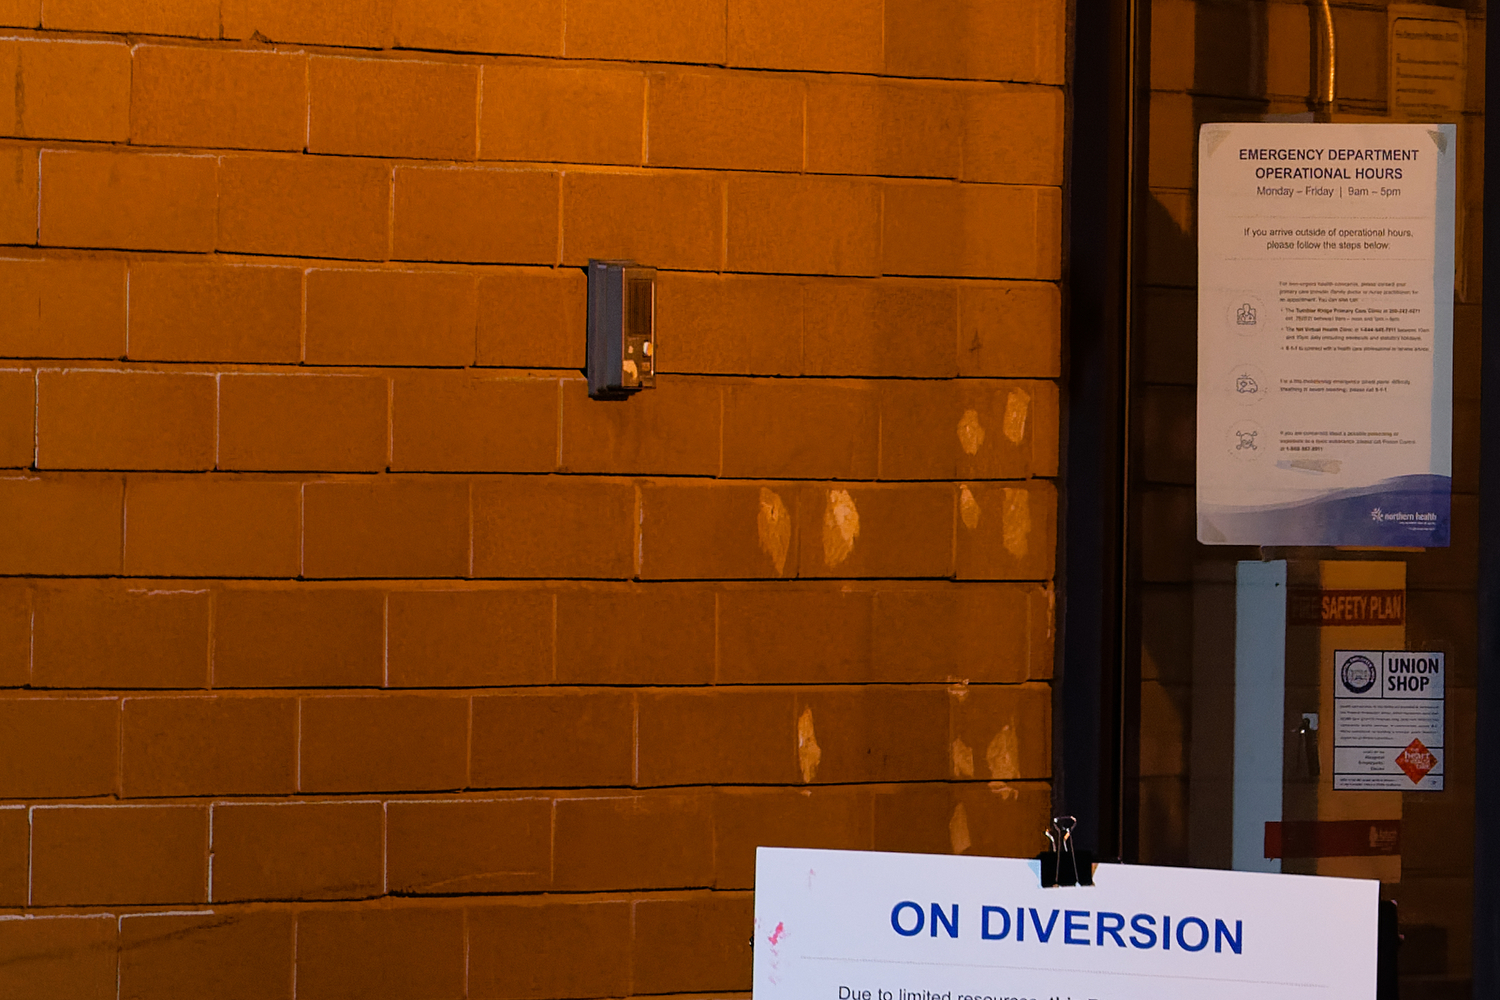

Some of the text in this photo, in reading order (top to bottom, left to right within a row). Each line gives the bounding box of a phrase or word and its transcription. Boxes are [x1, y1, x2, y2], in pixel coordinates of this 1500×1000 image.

[1239, 149, 1419, 161] EMERGENCY DEPARTMENT
[1255, 167, 1403, 180] OPERATIONAL HOURS
[1257, 185, 1401, 198] Monday Friday 9am 5pm
[1322, 596, 1367, 619] SAFETY
[1370, 595, 1401, 619] PLAN
[1388, 658, 1439, 674] UNION
[1388, 675, 1429, 692] SHOP
[891, 901, 1242, 954] ON DIVERSION
[839, 986, 871, 1000] Due
